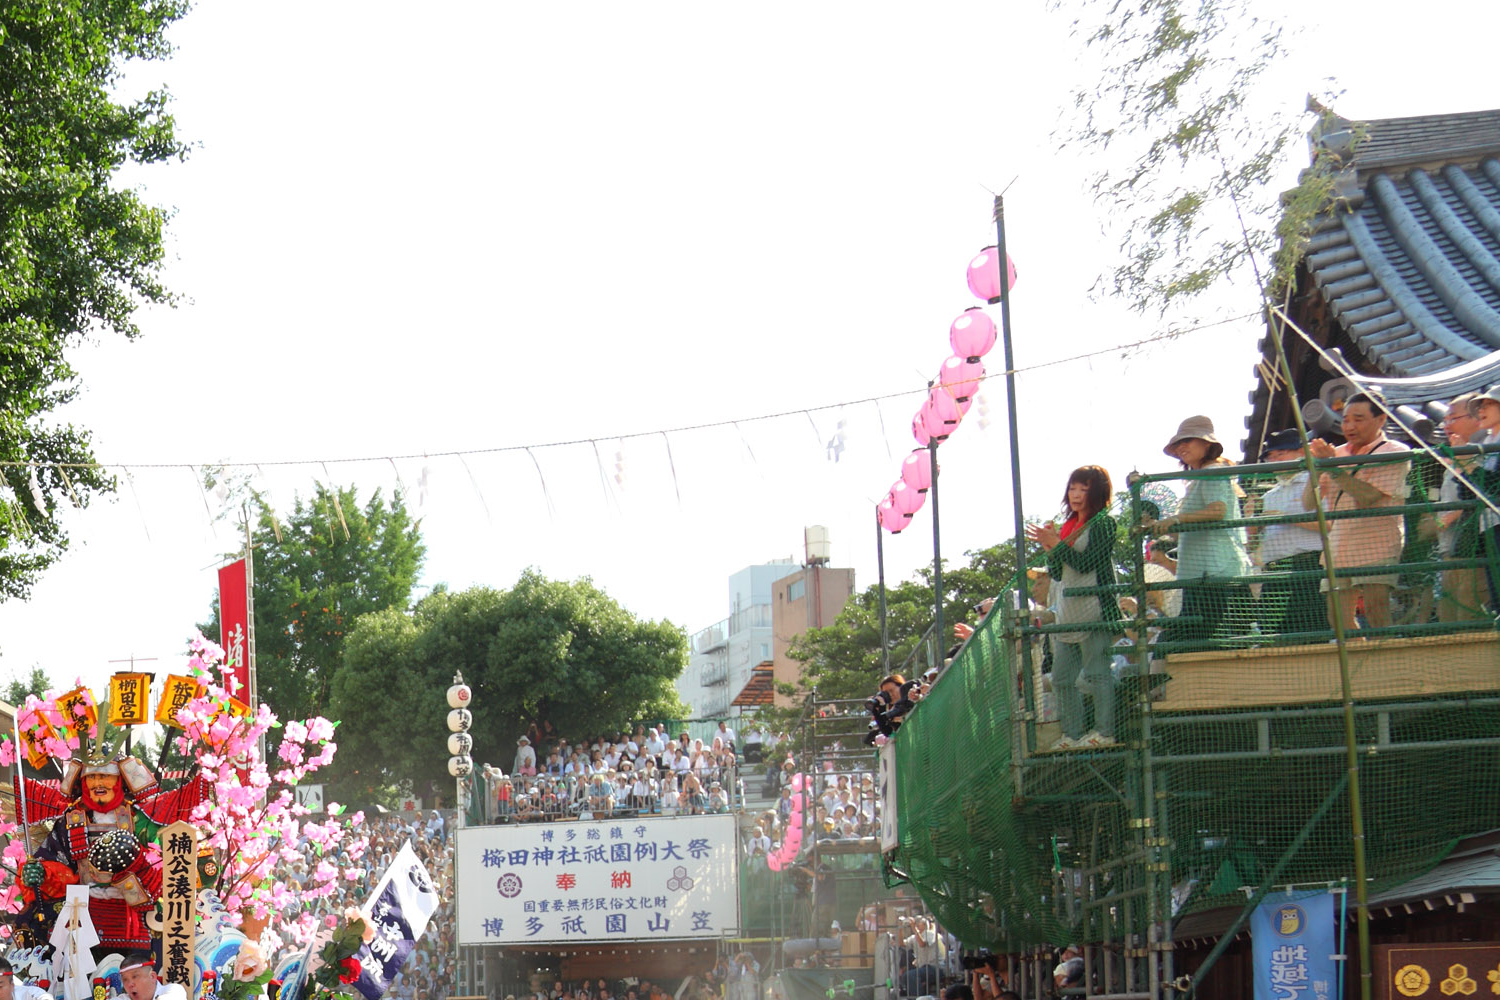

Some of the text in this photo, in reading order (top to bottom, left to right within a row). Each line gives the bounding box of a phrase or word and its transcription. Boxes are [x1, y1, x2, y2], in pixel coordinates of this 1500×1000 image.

[119, 680, 138, 719] 櫛田宮
[541, 825, 647, 842] 博多総鎮守
[482, 838, 713, 869] 櫛田神社祇園例大祭
[555, 870, 632, 891] 奉納
[166, 832, 193, 987] 楠公湊川之奮戦
[524, 896, 668, 913] 国重要無形民俗文化財
[481, 910, 714, 938] 博多祇園山笠
